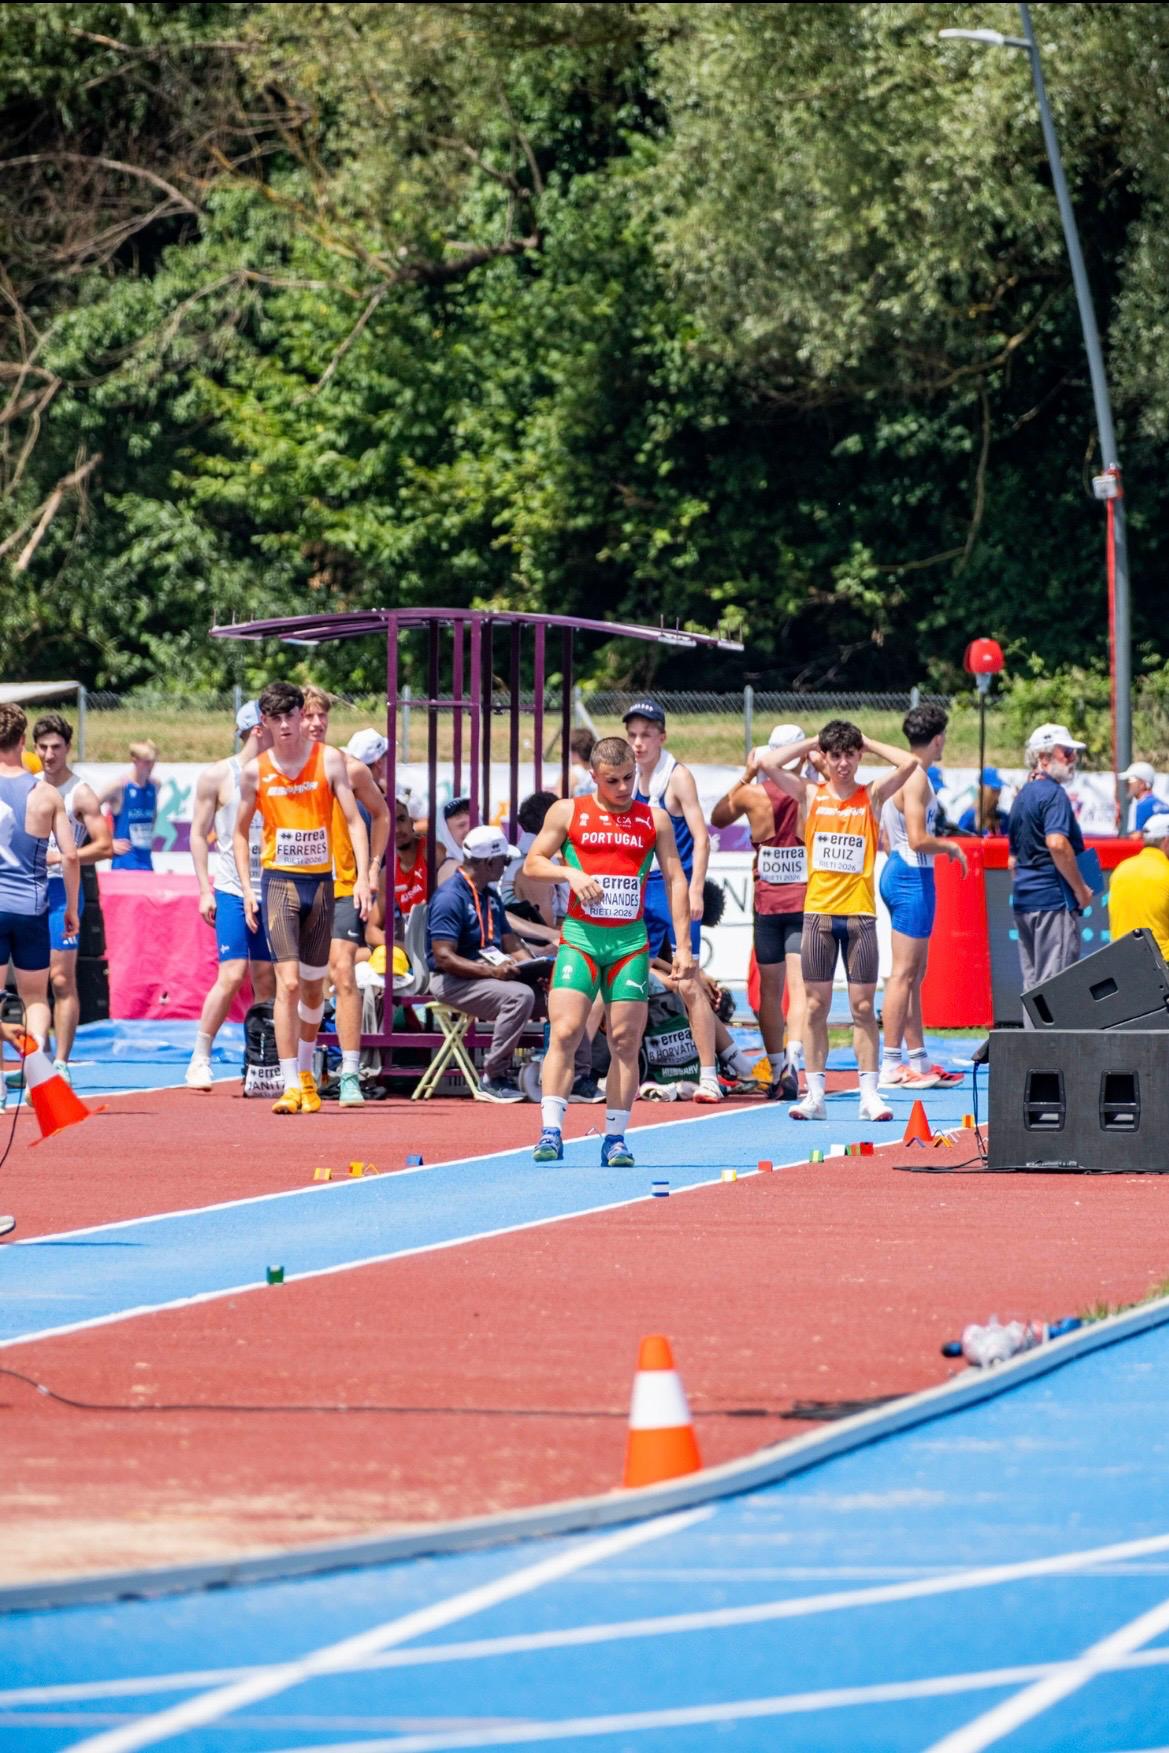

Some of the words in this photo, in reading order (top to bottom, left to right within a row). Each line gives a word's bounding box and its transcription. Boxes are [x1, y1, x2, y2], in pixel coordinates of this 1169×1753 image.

[294, 830, 325, 842] errea
[581, 832, 643, 848] PORTUGAL
[830, 834, 863, 848] errea
[277, 842, 327, 856] FERRERES
[773, 848, 805, 859] errea
[823, 847, 854, 861] RUIZ
[762, 860, 803, 873] DONIS
[602, 877, 638, 890] errea
[600, 893, 639, 907] NANDES
[589, 908, 612, 916] RIETI
[614, 909, 632, 917] 2026
[661, 1029, 691, 1046] errea
[258, 1067, 281, 1079] erre
